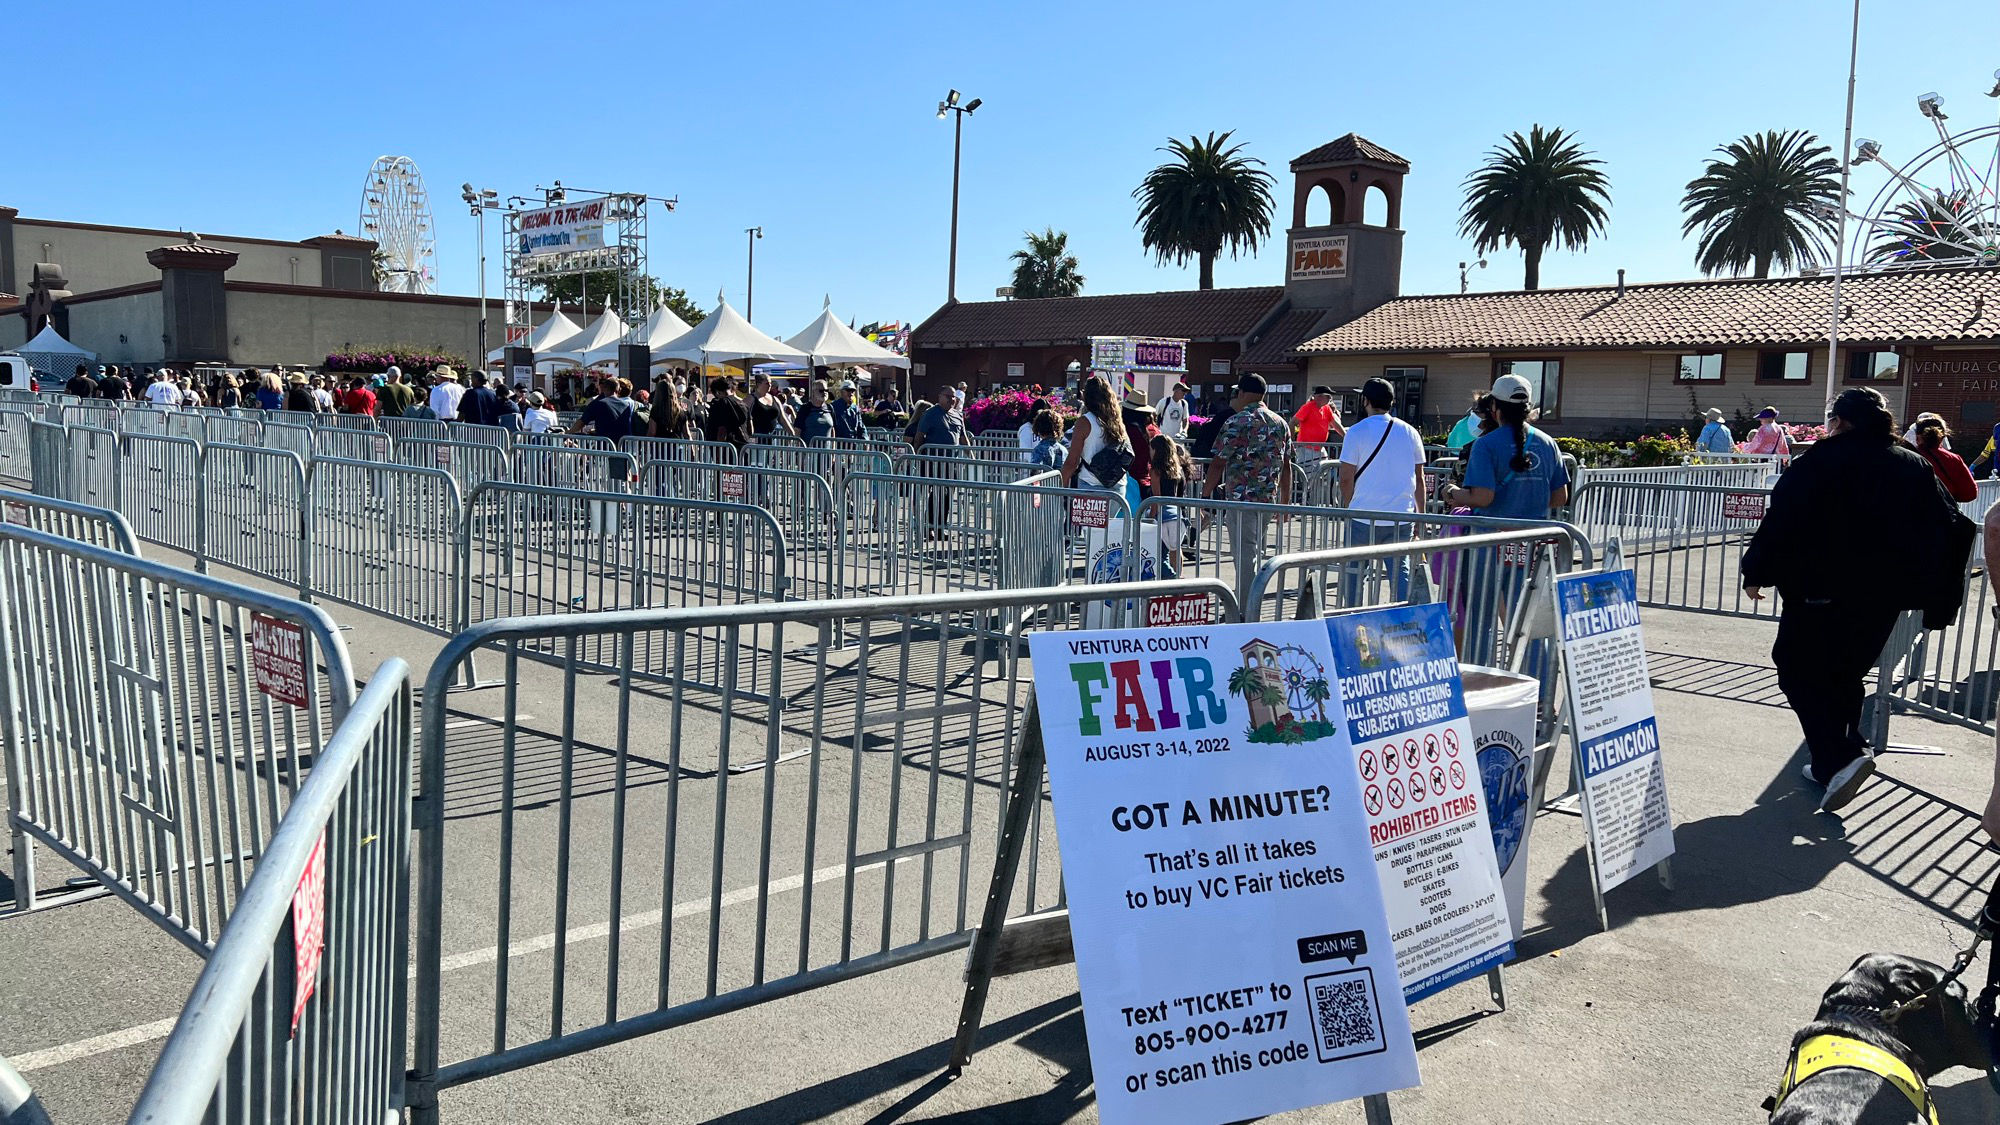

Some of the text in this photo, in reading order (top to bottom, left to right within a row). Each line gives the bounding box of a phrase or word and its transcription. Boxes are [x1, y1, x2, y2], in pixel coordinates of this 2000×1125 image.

[1295, 238, 1346, 249] VENTURA COUNTY
[1294, 249, 1344, 271] FAIR
[1136, 347, 1181, 362] TICKETS
[1914, 361, 2000, 373] VENTURA C
[1092, 542, 1121, 561] VENURA
[1565, 600, 1641, 640] ATTENTION
[1068, 635, 1209, 656] VENTURA COUNTY
[254, 651, 303, 680] SITE SERVICES
[1338, 657, 1458, 700] ECURITY CHECK POINT
[1069, 656, 1228, 737] FAIR
[1345, 682, 1452, 721] ALL PERSONS ENTERING
[1357, 701, 1450, 738] SUBJECT TO SEARCH
[1085, 737, 1230, 762] AUGUST 3-14, 2022
[1491, 730, 1525, 754] COUNTY
[1588, 722, 1656, 774] ATENCIÓN
[1112, 785, 1330, 832] GOT A MINUTE?
[1369, 794, 1478, 845] ROHIBITED ITEMS
[1375, 820, 1477, 861] UNS KNIVES TASERS STUN GUNS
[1391, 837, 1463, 868] DRUGS PARAPHERNALIA
[1144, 839, 1317, 874] That’s all it takes
[1406, 852, 1453, 875] BOTTLES CANS
[1125, 865, 1345, 910] to buy VC Fair tickets
[1403, 862, 1460, 888] BICYCLES E-BIKES
[1422, 879, 1446, 894] SKATES
[1420, 888, 1452, 907] SCOOTERS
[1429, 902, 1447, 915] DOGS
[1391, 927, 1415, 942] CASES,
[1415, 920, 1433, 933] BAGS
[1433, 916, 1442, 926] OR
[1443, 906, 1470, 922] COOLERS
[1308, 936, 1358, 956] SCAN ME
[1398, 960, 1411, 969] ck-in
[1441, 941, 1454, 951] Police
[1454, 931, 1478, 946] Department
[1405, 981, 1425, 995] fiscated
[1121, 982, 1292, 1027] Text “TICKET” to
[1134, 1010, 1288, 1056] 805-900-4277
[1125, 1040, 1309, 1093] or scan this code
